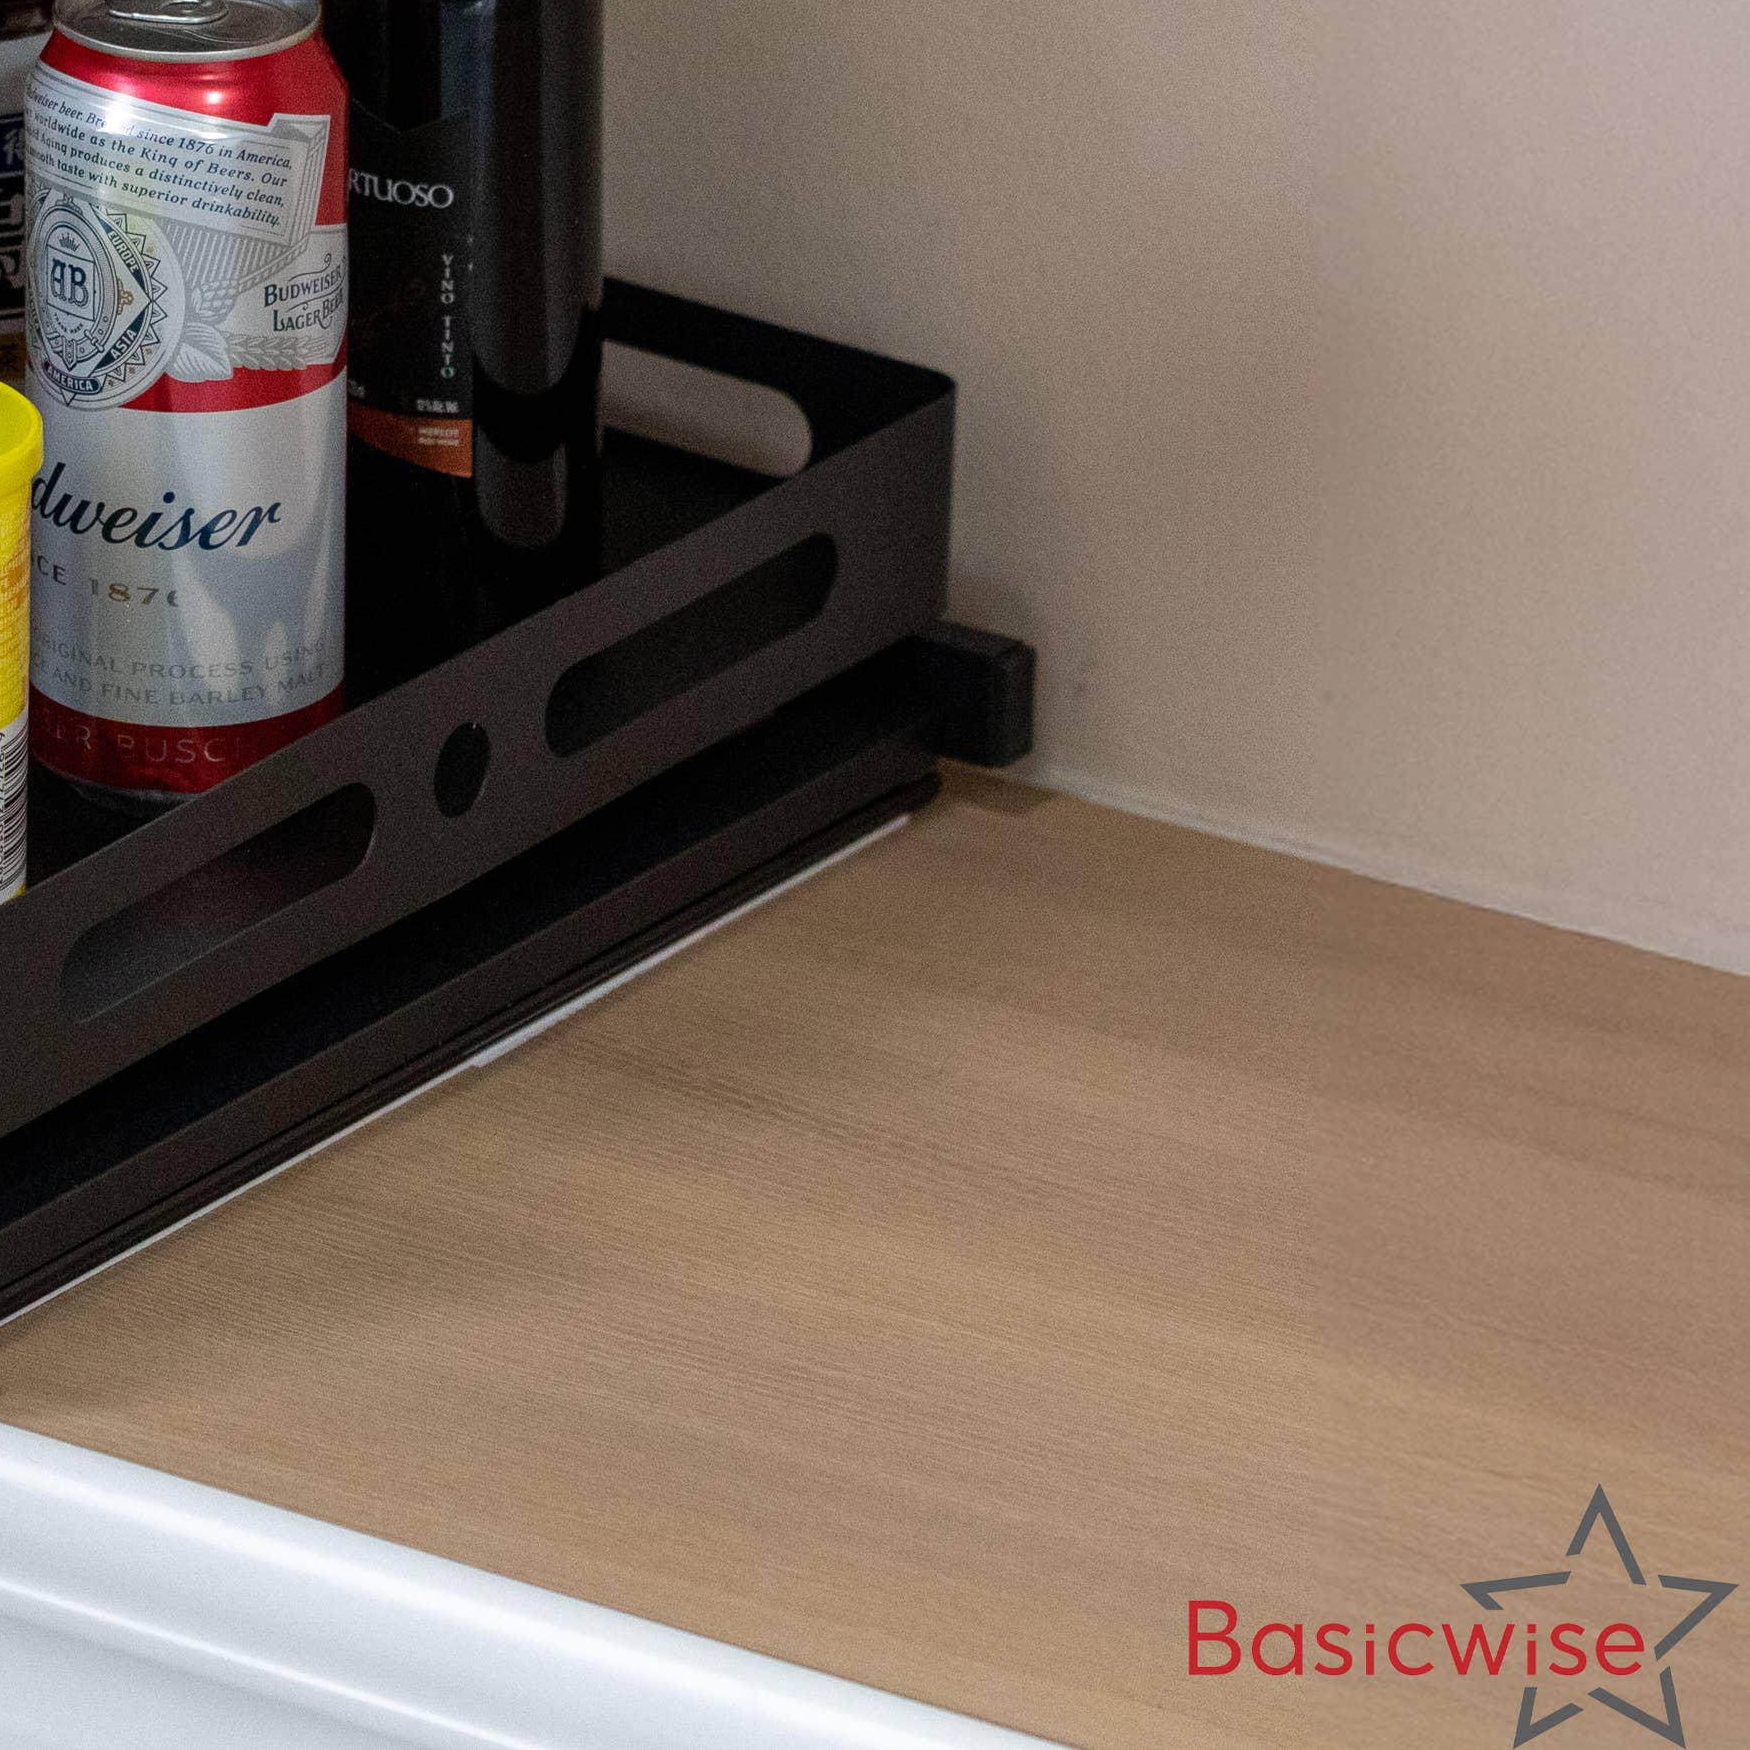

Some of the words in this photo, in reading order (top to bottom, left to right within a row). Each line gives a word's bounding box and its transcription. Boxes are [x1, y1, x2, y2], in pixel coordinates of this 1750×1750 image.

[34, 111, 86, 141] worldwide
[90, 134, 106, 148] as
[111, 138, 136, 156] the
[139, 146, 178, 168] King
[184, 157, 203, 173] of
[206, 162, 255, 182] Beers.
[260, 172, 288, 188] Our
[58, 100, 83, 122] beer.
[136, 127, 175, 148] since
[178, 136, 215, 155] 1876
[218, 143, 233, 159] in
[236, 148, 293, 171] America,
[41, 133, 68, 155] Aging
[70, 146, 131, 174] produces
[134, 166, 144, 177] a
[148, 168, 243, 200] distinctively
[246, 189, 285, 208] clean,
[57, 158, 86, 179] taste
[89, 170, 119, 189] with
[121, 181, 188, 207] superior
[191, 194, 282, 227] drinkability.
[108, 230, 138, 274] EUROPE
[51, 257, 90, 307] AB
[441, 253, 455, 305] VINO
[110, 328, 138, 361] ASIA
[49, 367, 94, 392] AMERICA
[31, 555, 67, 586] CE
[52, 669, 94, 693] AND
[101, 682, 157, 706] FINE
[169, 683, 267, 707] BARLEY
[132, 660, 254, 681] PROCESS
